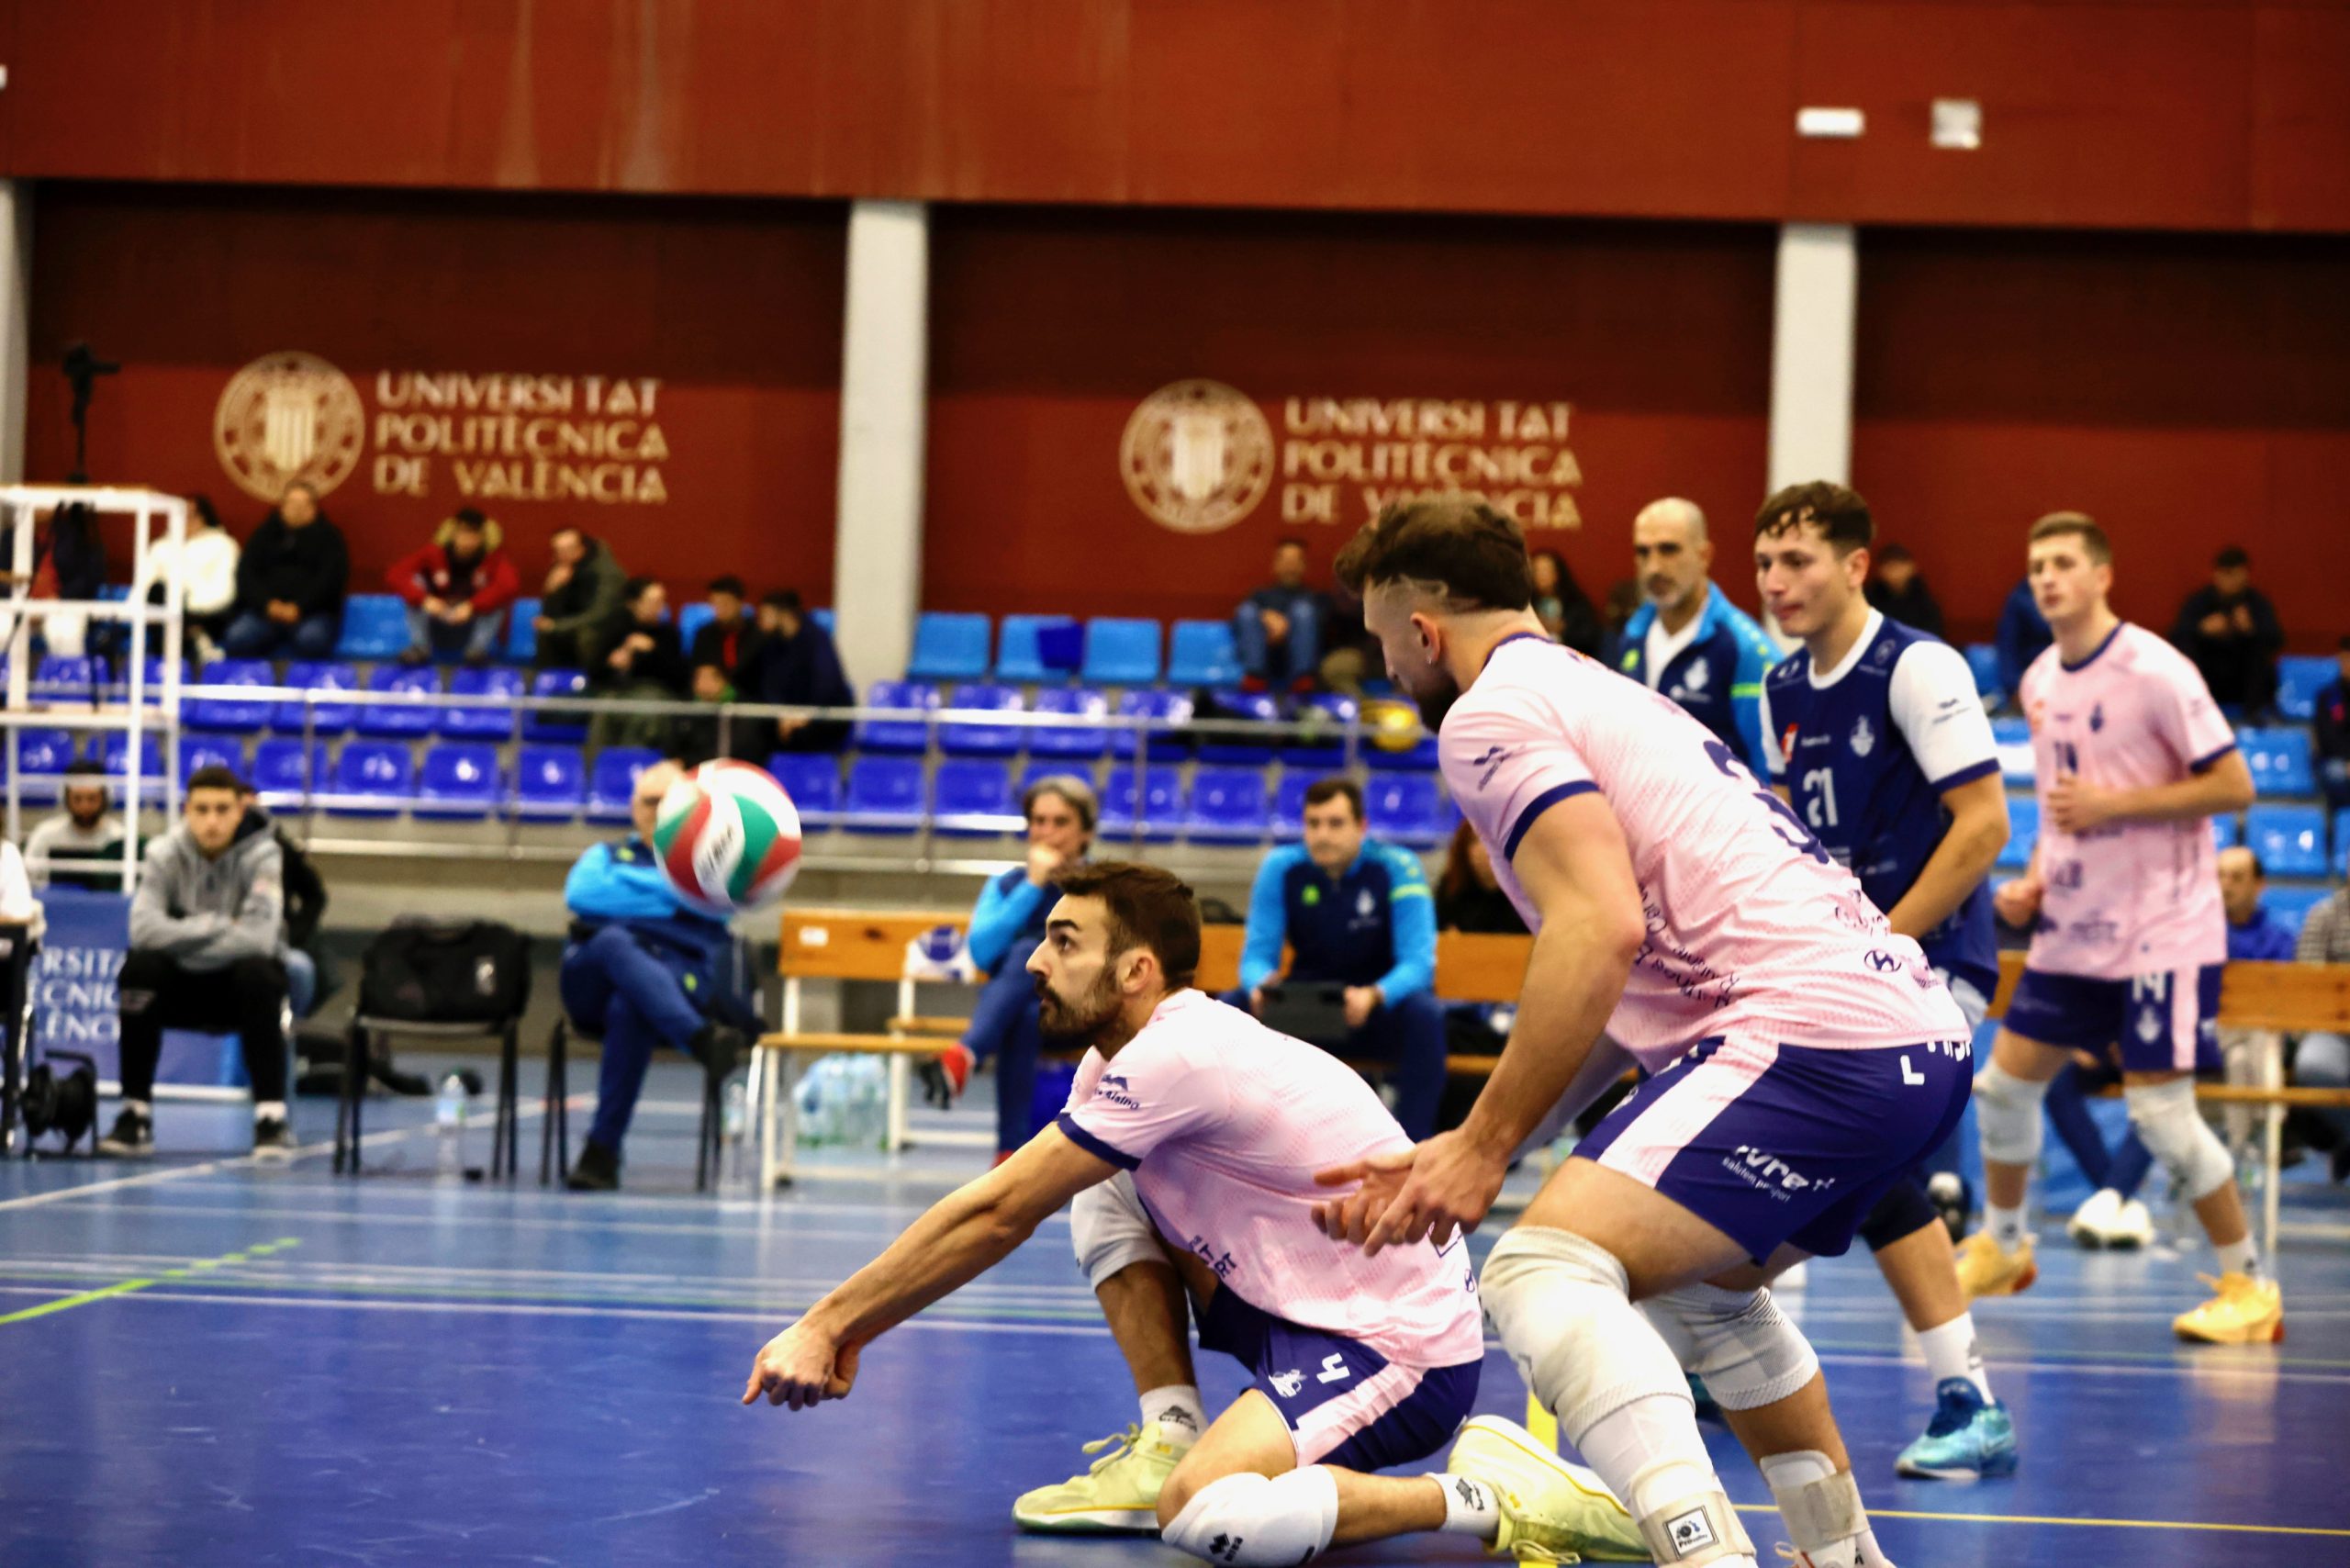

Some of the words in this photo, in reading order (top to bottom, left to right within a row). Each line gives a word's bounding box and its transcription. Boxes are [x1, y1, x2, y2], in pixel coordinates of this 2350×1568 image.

[374, 453, 429, 497] DE
[1282, 482, 1340, 524] DE
[1803, 767, 1839, 827] 21
